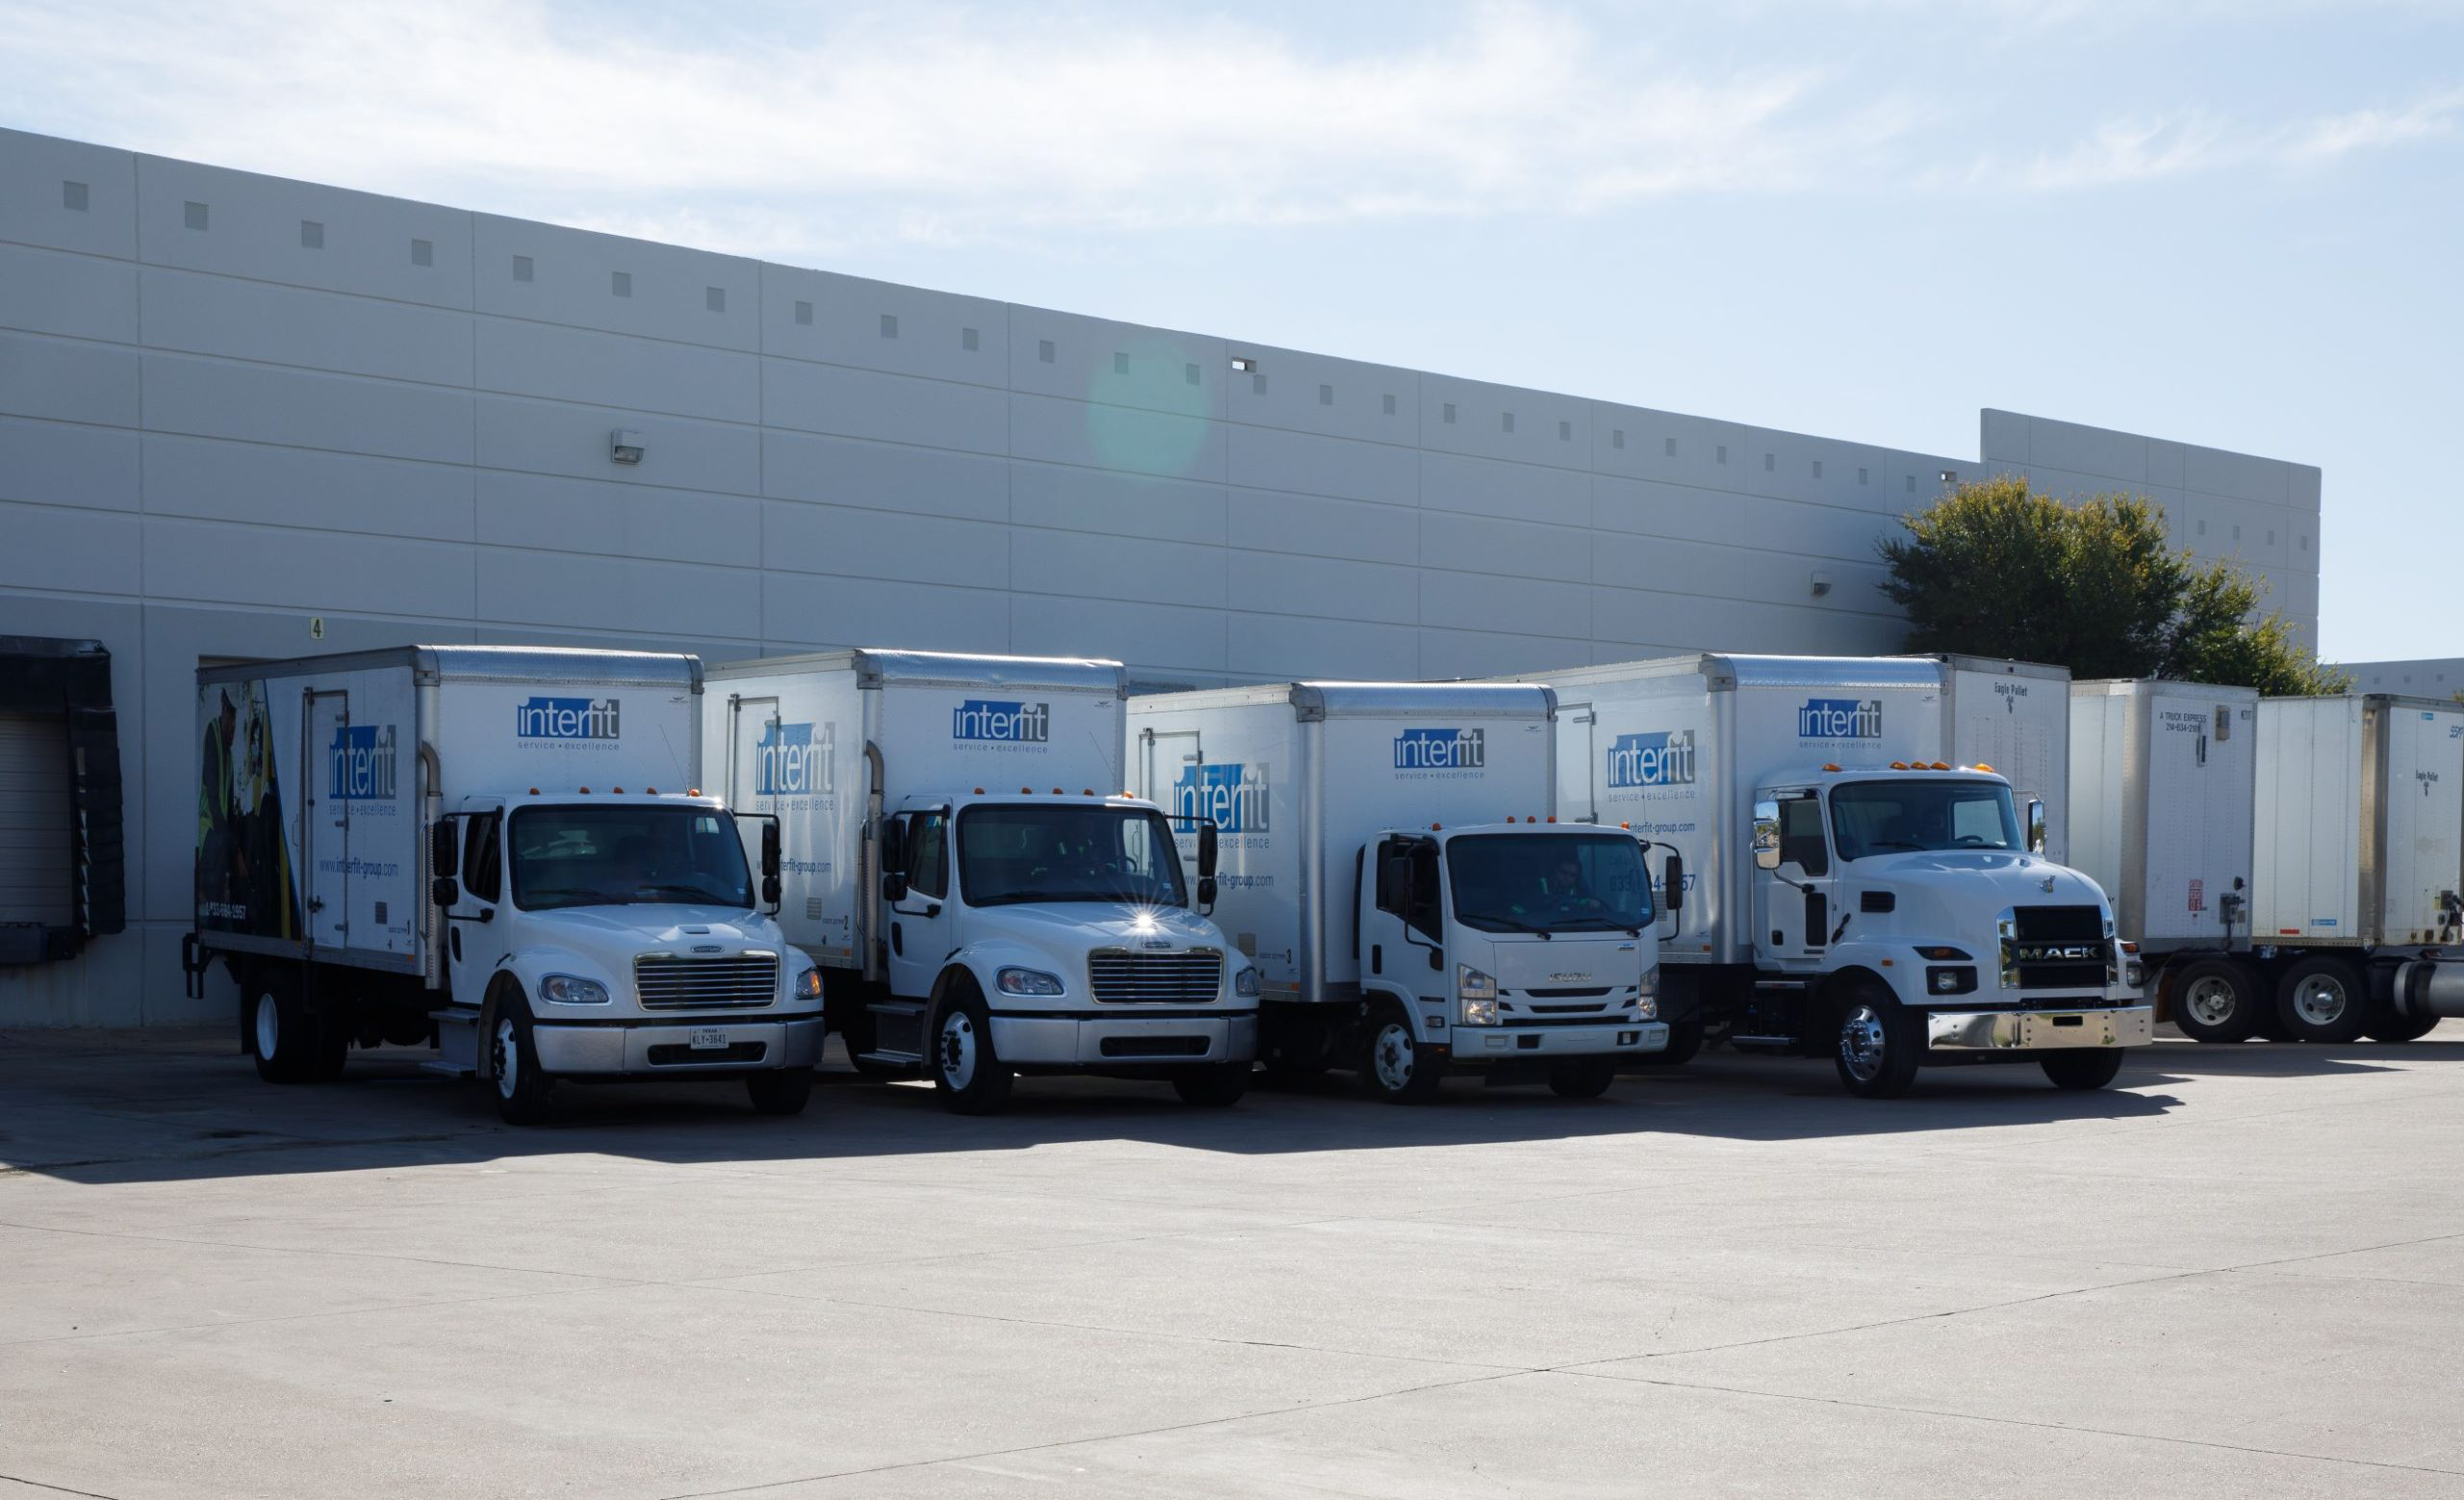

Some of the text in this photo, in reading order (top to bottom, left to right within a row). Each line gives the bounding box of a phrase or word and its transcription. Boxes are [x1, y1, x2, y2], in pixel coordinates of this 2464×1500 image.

[313, 618, 322, 638] 4
[518, 697, 620, 739] interfit
[953, 700, 1049, 741] interfit
[1799, 699, 1882, 738] interfit
[518, 740, 620, 752] service excellence
[953, 742, 1048, 754] service excellence
[1395, 728, 1485, 768] interfit
[1799, 740, 1882, 750] service excellence
[329, 725, 396, 799] interfit
[757, 722, 835, 795] interfit
[1608, 730, 1695, 788] interfit
[1435, 771, 1485, 780] excellence
[1174, 763, 1270, 834] interfit
[1608, 789, 1695, 803] service excellence
[360, 803, 397, 817] excellence
[756, 798, 834, 812] servce excellence
[1630, 821, 1696, 835] nterfit-group.com
[1174, 837, 1270, 849] servi excellence
[844, 915, 849, 930] 2
[1286, 948, 1292, 965] 3
[2019, 947, 2099, 960] MACK
[1550, 971, 1594, 983] ISUZU
